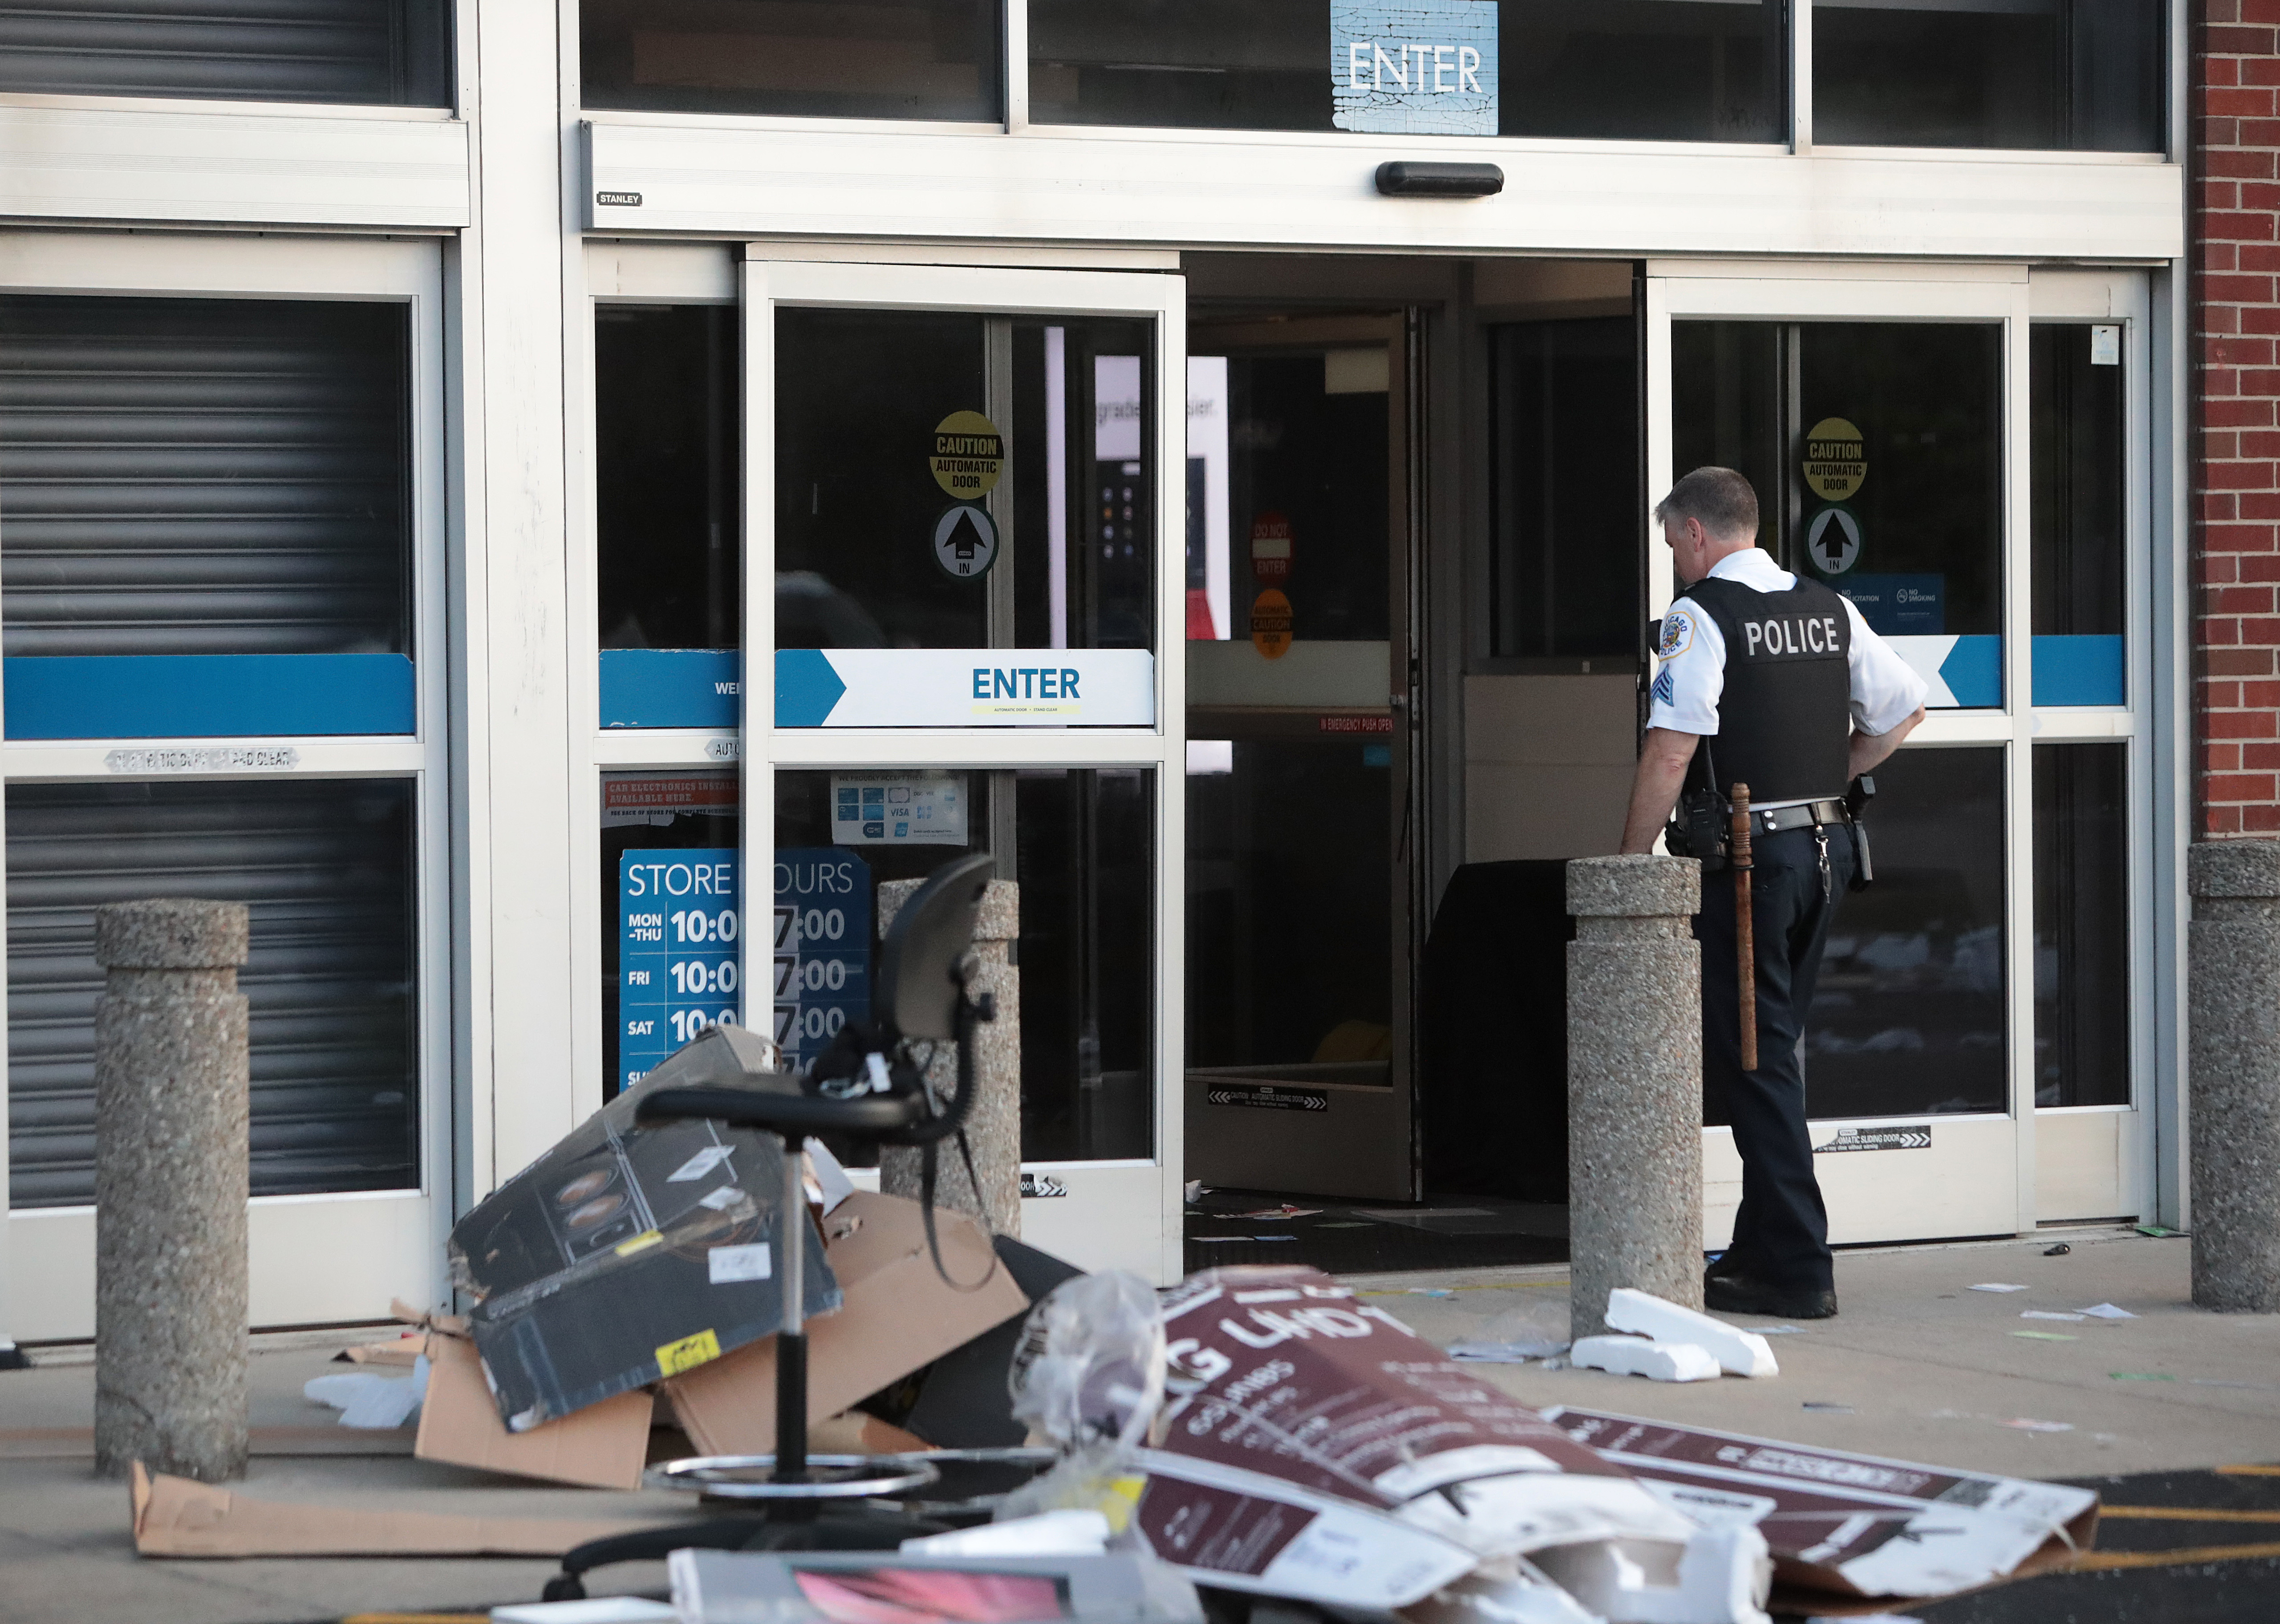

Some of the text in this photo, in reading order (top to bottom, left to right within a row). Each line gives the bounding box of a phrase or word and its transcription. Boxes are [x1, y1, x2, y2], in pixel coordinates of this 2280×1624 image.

[1350, 42, 1482, 93] ENTER
[600, 195, 639, 203] STANLEY
[937, 436, 997, 455] CAUTION
[1809, 443, 1862, 459] CAUTION
[936, 459, 997, 473] AUTOMATIC
[1809, 464, 1862, 476] AUTOMATIC
[953, 475, 981, 488] DOOR
[1824, 479, 1848, 490] DOOR
[1255, 523, 1288, 537] DO NOT
[959, 563, 970, 574] IN
[1257, 560, 1286, 574] ENTER
[1830, 560, 1839, 570] IN
[1253, 617, 1291, 629] CAUTION
[1744, 618, 1839, 656] POLICE
[973, 668, 1081, 699] ENTER
[1328, 718, 1361, 731] EMERGENCY
[1362, 718, 1377, 731] PUSH
[1378, 718, 1393, 731] OPEN
[631, 782, 696, 792] ELECTRONICS
[610, 795, 663, 803] AVAILABLE
[890, 808, 909, 817] VISA
[628, 863, 853, 896] STORE OURS
[629, 914, 661, 927] MON
[670, 909, 738, 942] 10:0
[628, 971, 650, 985] FRI
[670, 960, 738, 994] 10:0
[628, 1021, 654, 1035] SAT
[1860, 1135, 1882, 1144] SLIDING
[1883, 1134, 1899, 1142] DOOR
[1021, 1181, 1035, 1191] OOR
